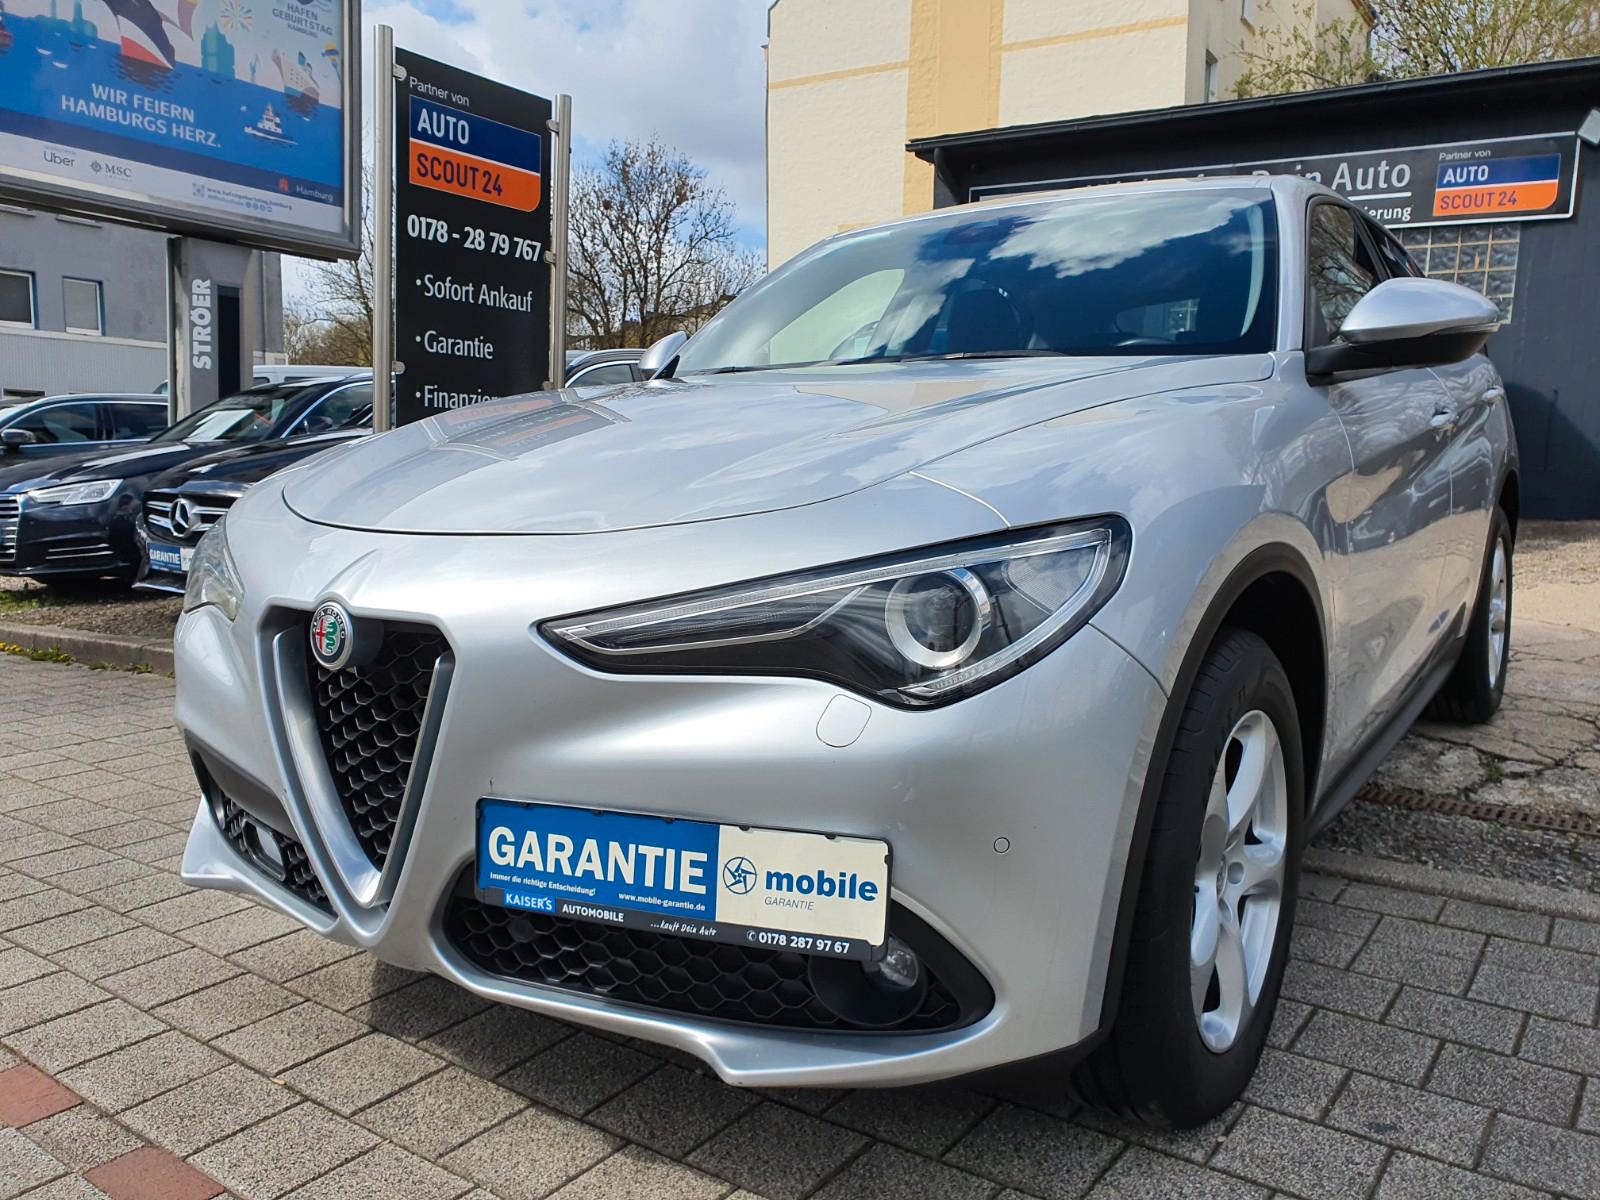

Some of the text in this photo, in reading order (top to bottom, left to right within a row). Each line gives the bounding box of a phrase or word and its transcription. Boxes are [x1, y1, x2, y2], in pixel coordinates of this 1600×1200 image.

[272, 8, 333, 36] GEBURTSTAG
[287, 2, 318, 21] HAFEN
[91, 83, 195, 123] WIR FEIERN
[409, 76, 470, 107] Partner von
[61, 95, 222, 148] HAMBURGS HERZ.
[417, 108, 470, 145] AUTO
[43, 150, 76, 167] Uber
[1439, 150, 1491, 161] Partner von
[105, 163, 133, 178] MSC
[416, 152, 503, 196] SCOUT24
[1331, 160, 1411, 191] Auto
[1443, 165, 1489, 184] AUTO
[296, 184, 334, 202] Hamburg
[1440, 190, 1517, 210] SCOUT24
[1363, 206, 1412, 222] erung
[407, 214, 449, 243] 0178
[463, 226, 486, 251] 28
[489, 232, 510, 256] 79
[513, 237, 542, 262] 767
[424, 274, 533, 313] Sofort Ankauf
[191, 278, 212, 370] STRÖER
[424, 330, 494, 360] Garantie
[488, 825, 708, 895] GARANTIE
[489, 871, 597, 897] Immer die richtige Entscheidung!
[765, 869, 879, 902] mobile
[562, 903, 625, 923] AUTOMOBILE
[618, 892, 706, 912] www.mobile-garantie.de
[764, 896, 815, 911] GARANTIE
[680, 923, 697, 935] Dein
[699, 925, 717, 937] Auto
[758, 931, 850, 954] 0178 287 97 67
